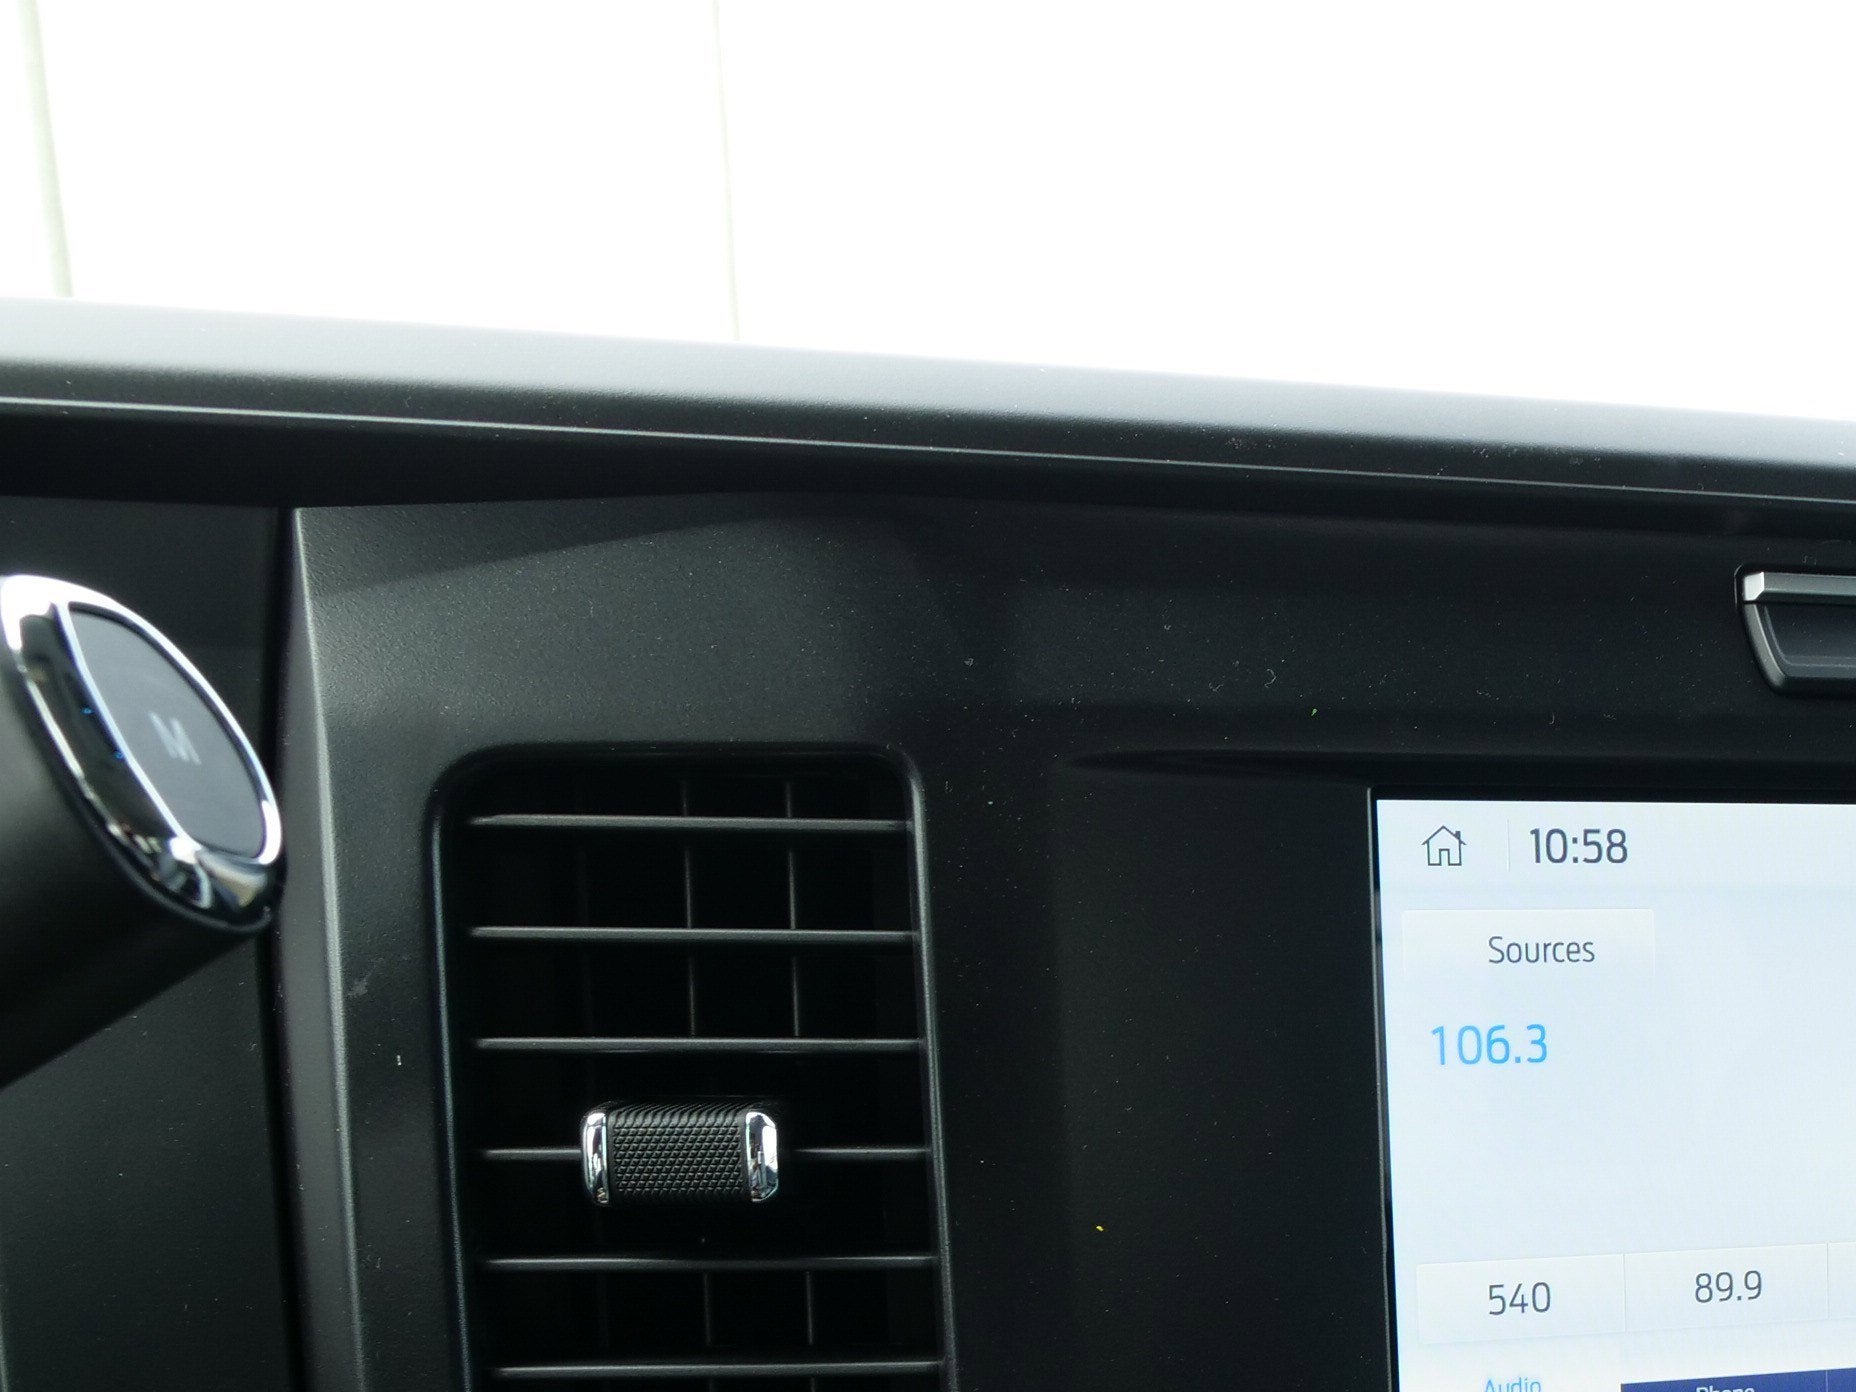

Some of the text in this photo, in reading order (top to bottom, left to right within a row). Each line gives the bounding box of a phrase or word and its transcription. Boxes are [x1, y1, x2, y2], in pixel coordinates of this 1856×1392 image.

[1529, 828, 1628, 864] 10:58
[1488, 935, 1596, 964] Sources
[1431, 1023, 1548, 1066] 106.3
[1488, 1281, 1552, 1316] 540
[1695, 1270, 1762, 1304] 89.9
